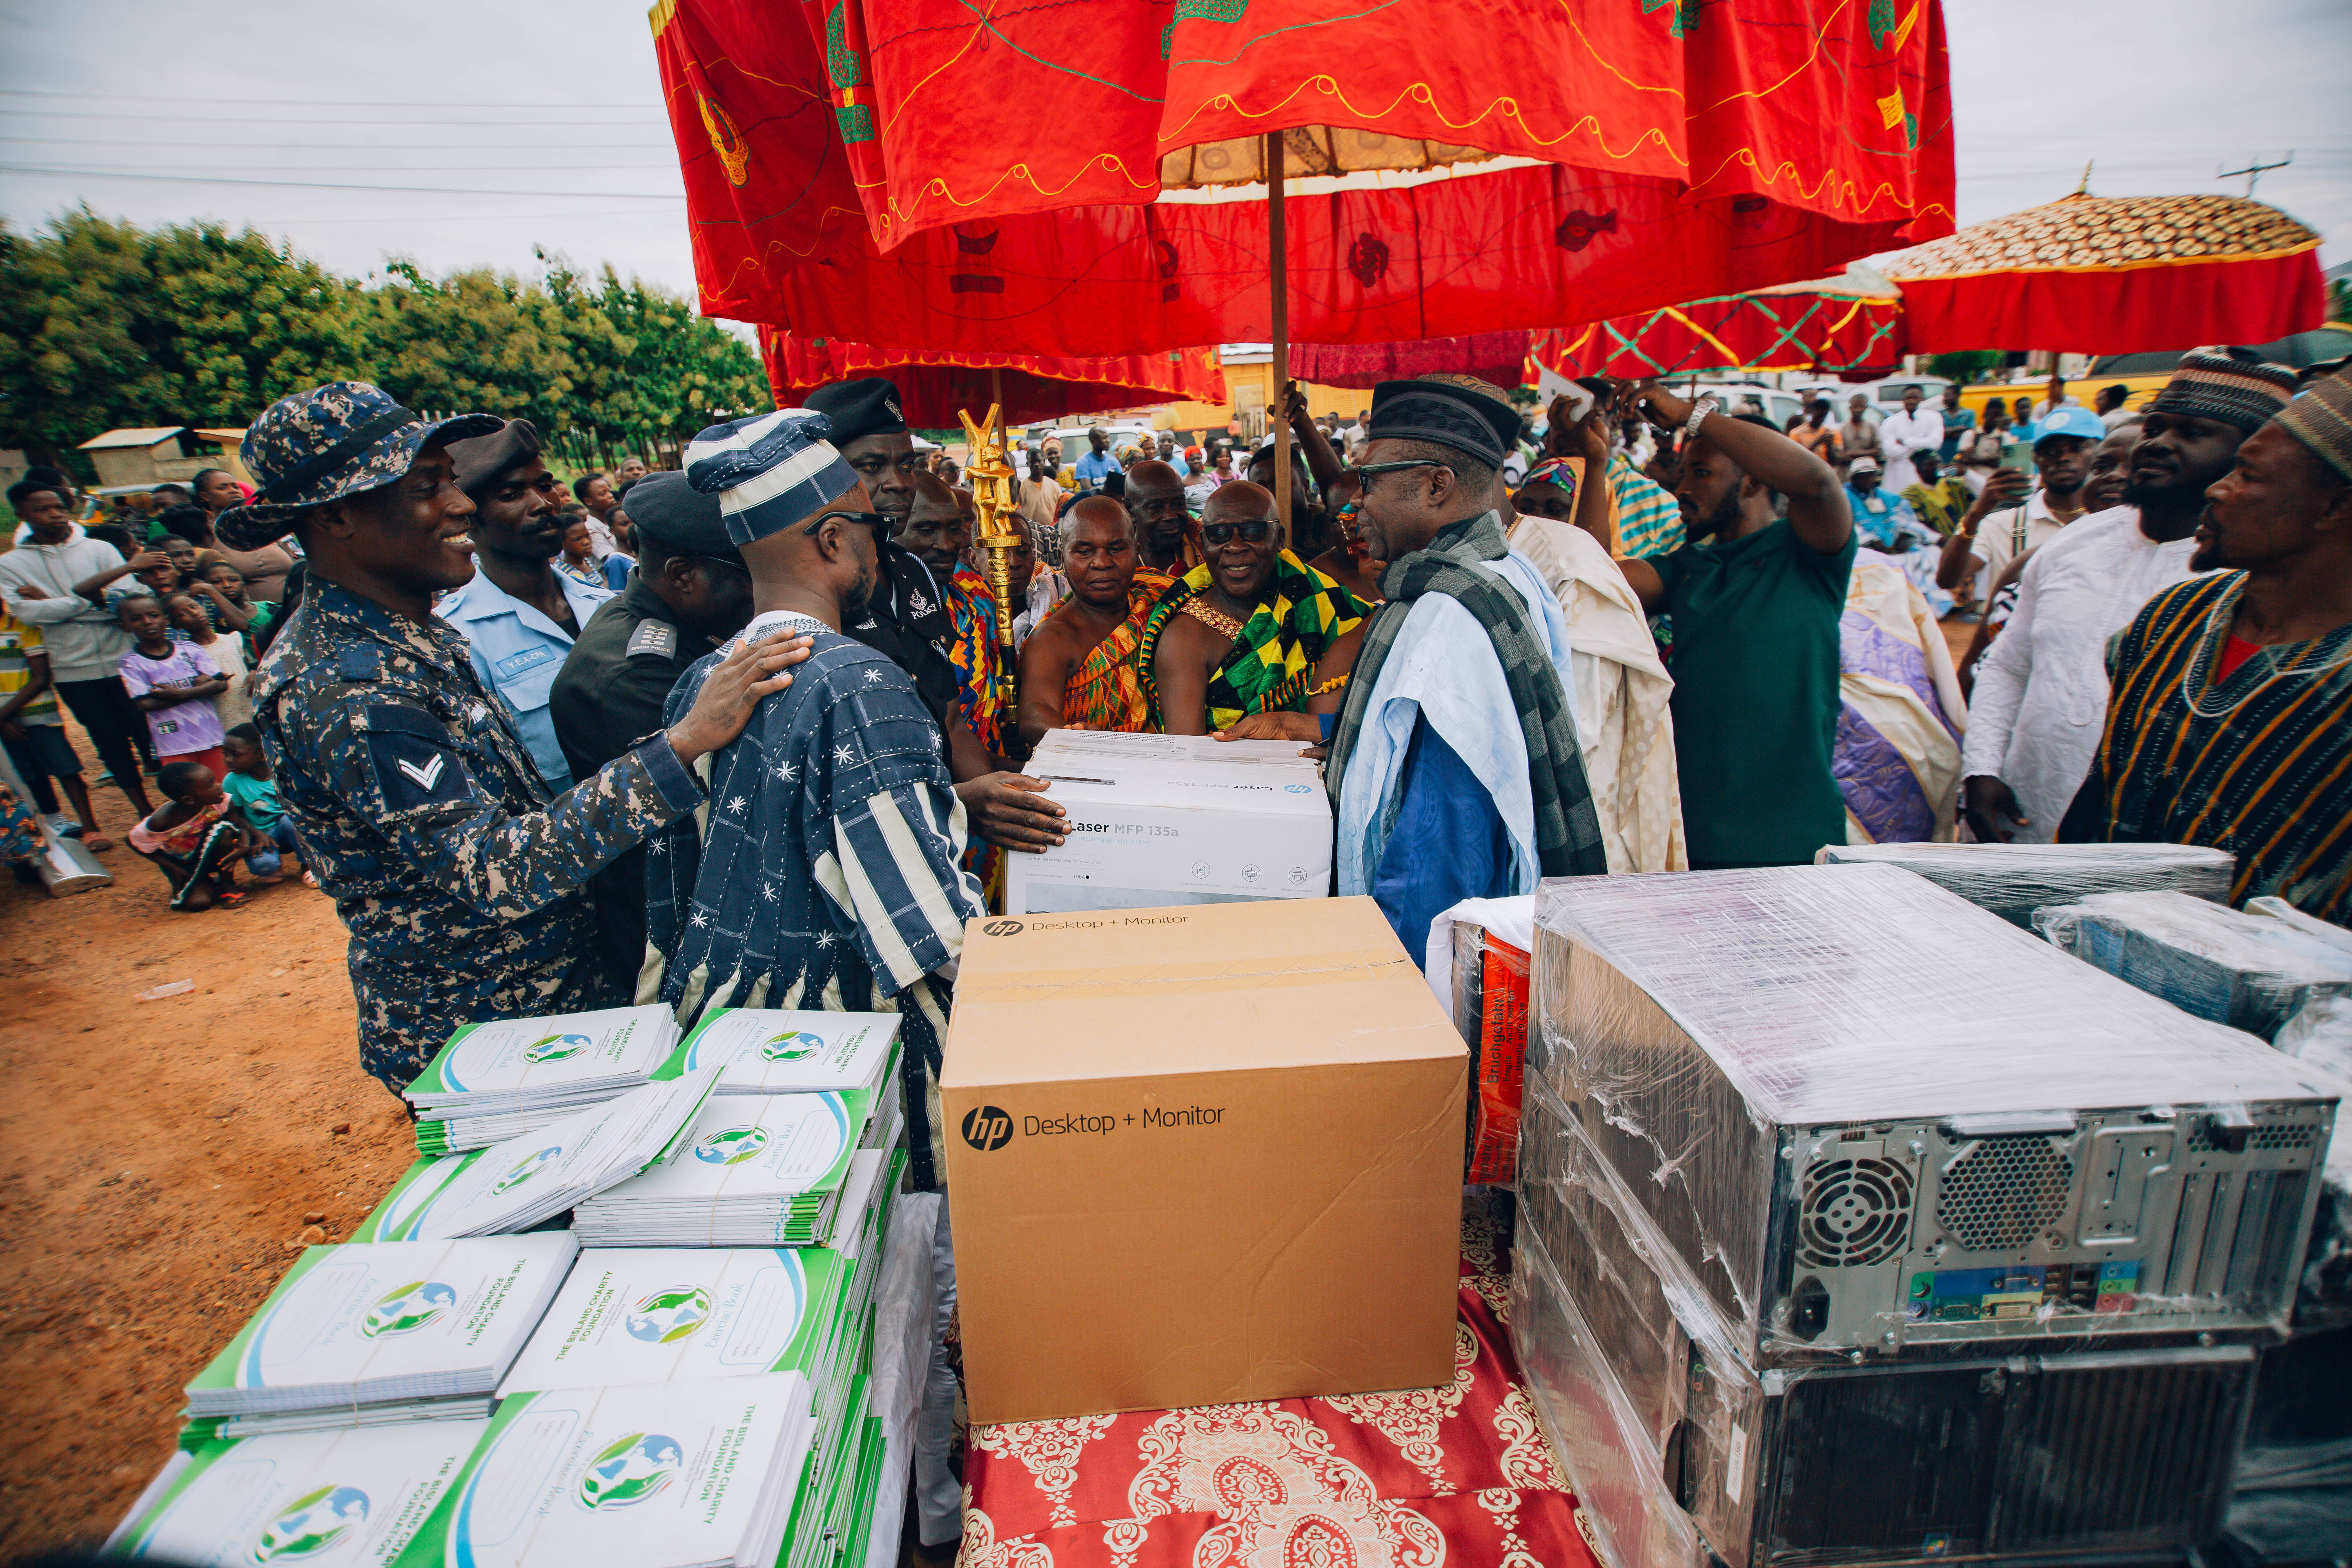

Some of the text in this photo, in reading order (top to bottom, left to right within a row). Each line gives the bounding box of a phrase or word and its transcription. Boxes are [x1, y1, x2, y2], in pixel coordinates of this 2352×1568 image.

[1286, 784, 1310, 794] hp
[1114, 824, 1143, 835] MFP
[1148, 826, 1178, 837] 135a
[984, 920, 1021, 937] hp
[1032, 920, 1103, 931] Desktop
[1125, 915, 1189, 925] Monitor
[1507, 990, 1515, 1019] werfen
[607, 1029, 624, 1056] FOUNDATION
[611, 1019, 637, 1063] THE BISLAND CHARITY
[834, 1035, 857, 1063] FOUNDATION
[837, 1026, 871, 1073] THE BISLAND CHARITY
[1487, 997, 1506, 1083] Bruchgefahr
[1515, 1042, 1523, 1071] Handle
[1503, 1055, 1512, 1082] Fragile
[964, 1106, 1011, 1152] hp
[1024, 1105, 1226, 1136] Desktop + Monitor
[763, 1123, 796, 1168] Exercise Book
[511, 1258, 526, 1274] THE
[465, 1278, 505, 1330] FOUNDATION
[490, 1276, 517, 1310] BISLAND
[466, 1312, 494, 1346] CHARITY
[555, 1270, 614, 1361] THE BISLAND CHARITY
[579, 1289, 616, 1341] FOUNDATION
[704, 1283, 744, 1348] Exercise Book
[438, 1454, 457, 1477] THE
[699, 1428, 735, 1501] FOUNDATION
[703, 1403, 756, 1525] THE BISLAND CHARITY
[374, 1481, 428, 1556] FOUNDATION
[408, 1479, 443, 1528] BISLAND
